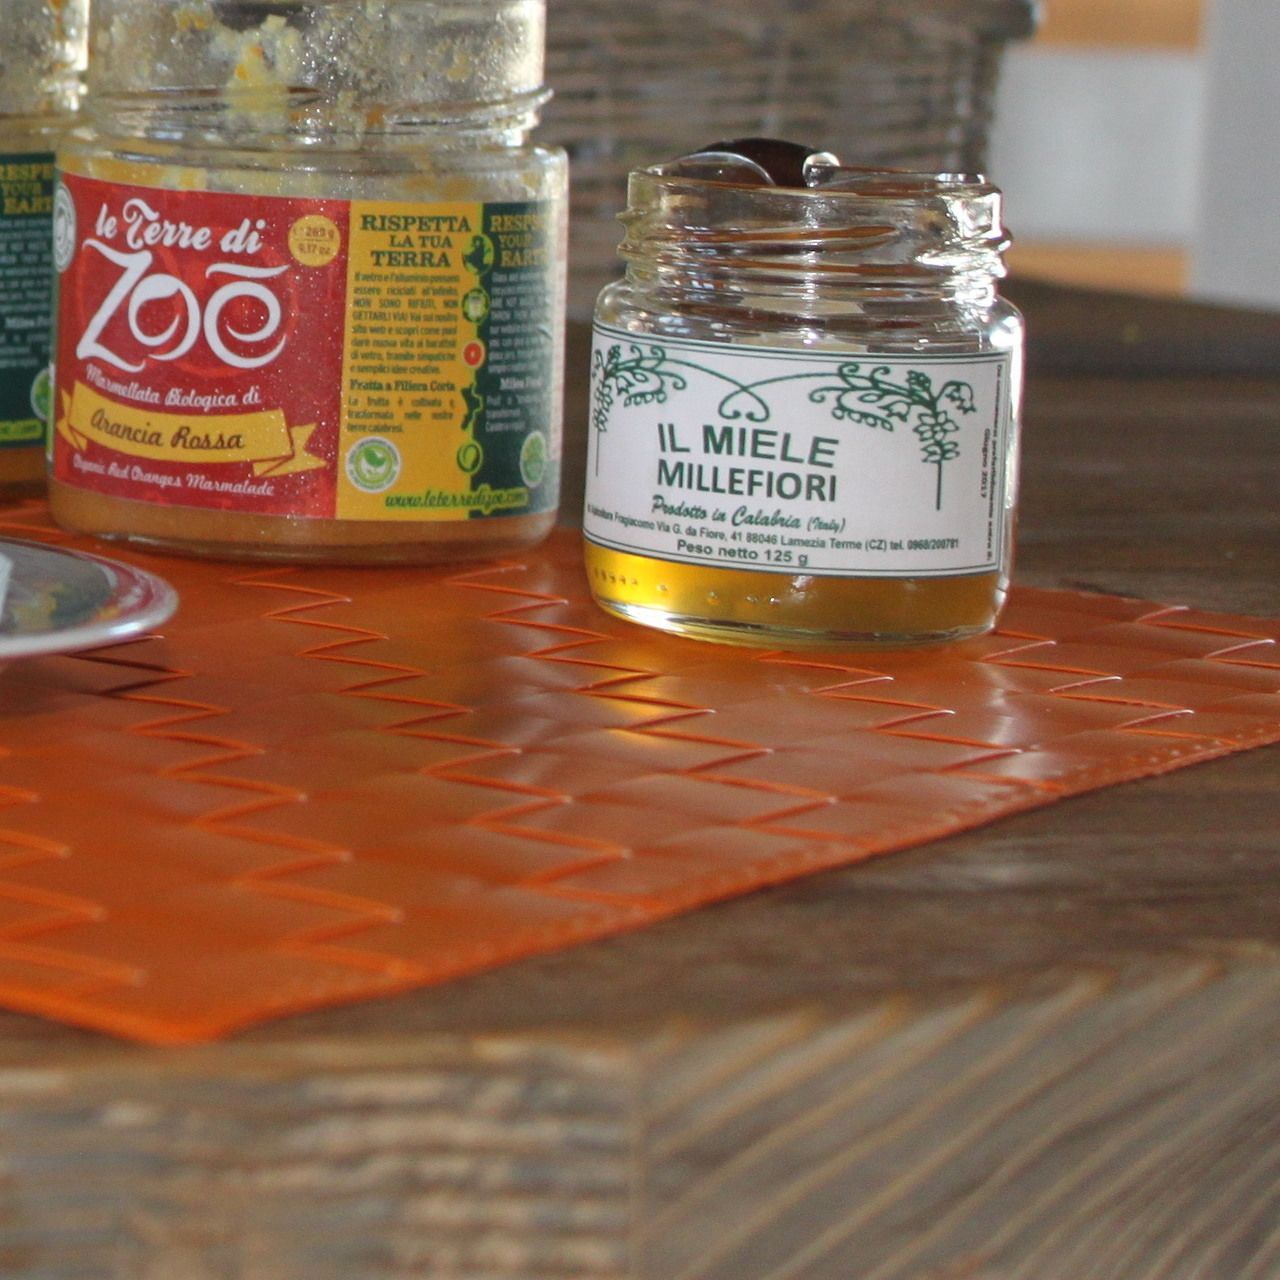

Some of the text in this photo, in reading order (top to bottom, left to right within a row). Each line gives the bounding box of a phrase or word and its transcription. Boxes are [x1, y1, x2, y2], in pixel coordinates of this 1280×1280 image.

[95, 198, 266, 254] le Terre di
[360, 215, 472, 232] RISPETTA
[370, 250, 451, 267] TERRA
[389, 235, 452, 248] LA TUA
[86, 364, 262, 411] Marmellata Biologica di
[90, 408, 245, 450] Arancia Rossa
[657, 423, 839, 468] IL MIELE
[107, 461, 130, 480] Red
[131, 466, 182, 488] Oranges
[186, 473, 275, 496] Marmalade
[657, 458, 836, 502] MILLEFIORI
[651, 494, 707, 520] Prodotto
[712, 508, 726, 522] in
[731, 505, 801, 529] Calabria
[656, 520, 670, 532] Via
[672, 523, 683, 534] G.
[685, 526, 697, 537] da
[699, 527, 727, 541] Fiore,
[730, 531, 742, 542] 41
[746, 532, 777, 545] 88046
[780, 535, 826, 549] Lamezia
[829, 537, 862, 550] Terme
[865, 538, 887, 552] (CZ)
[890, 539, 904, 551] tel.
[676, 539, 809, 566] Peso netto 125 g
